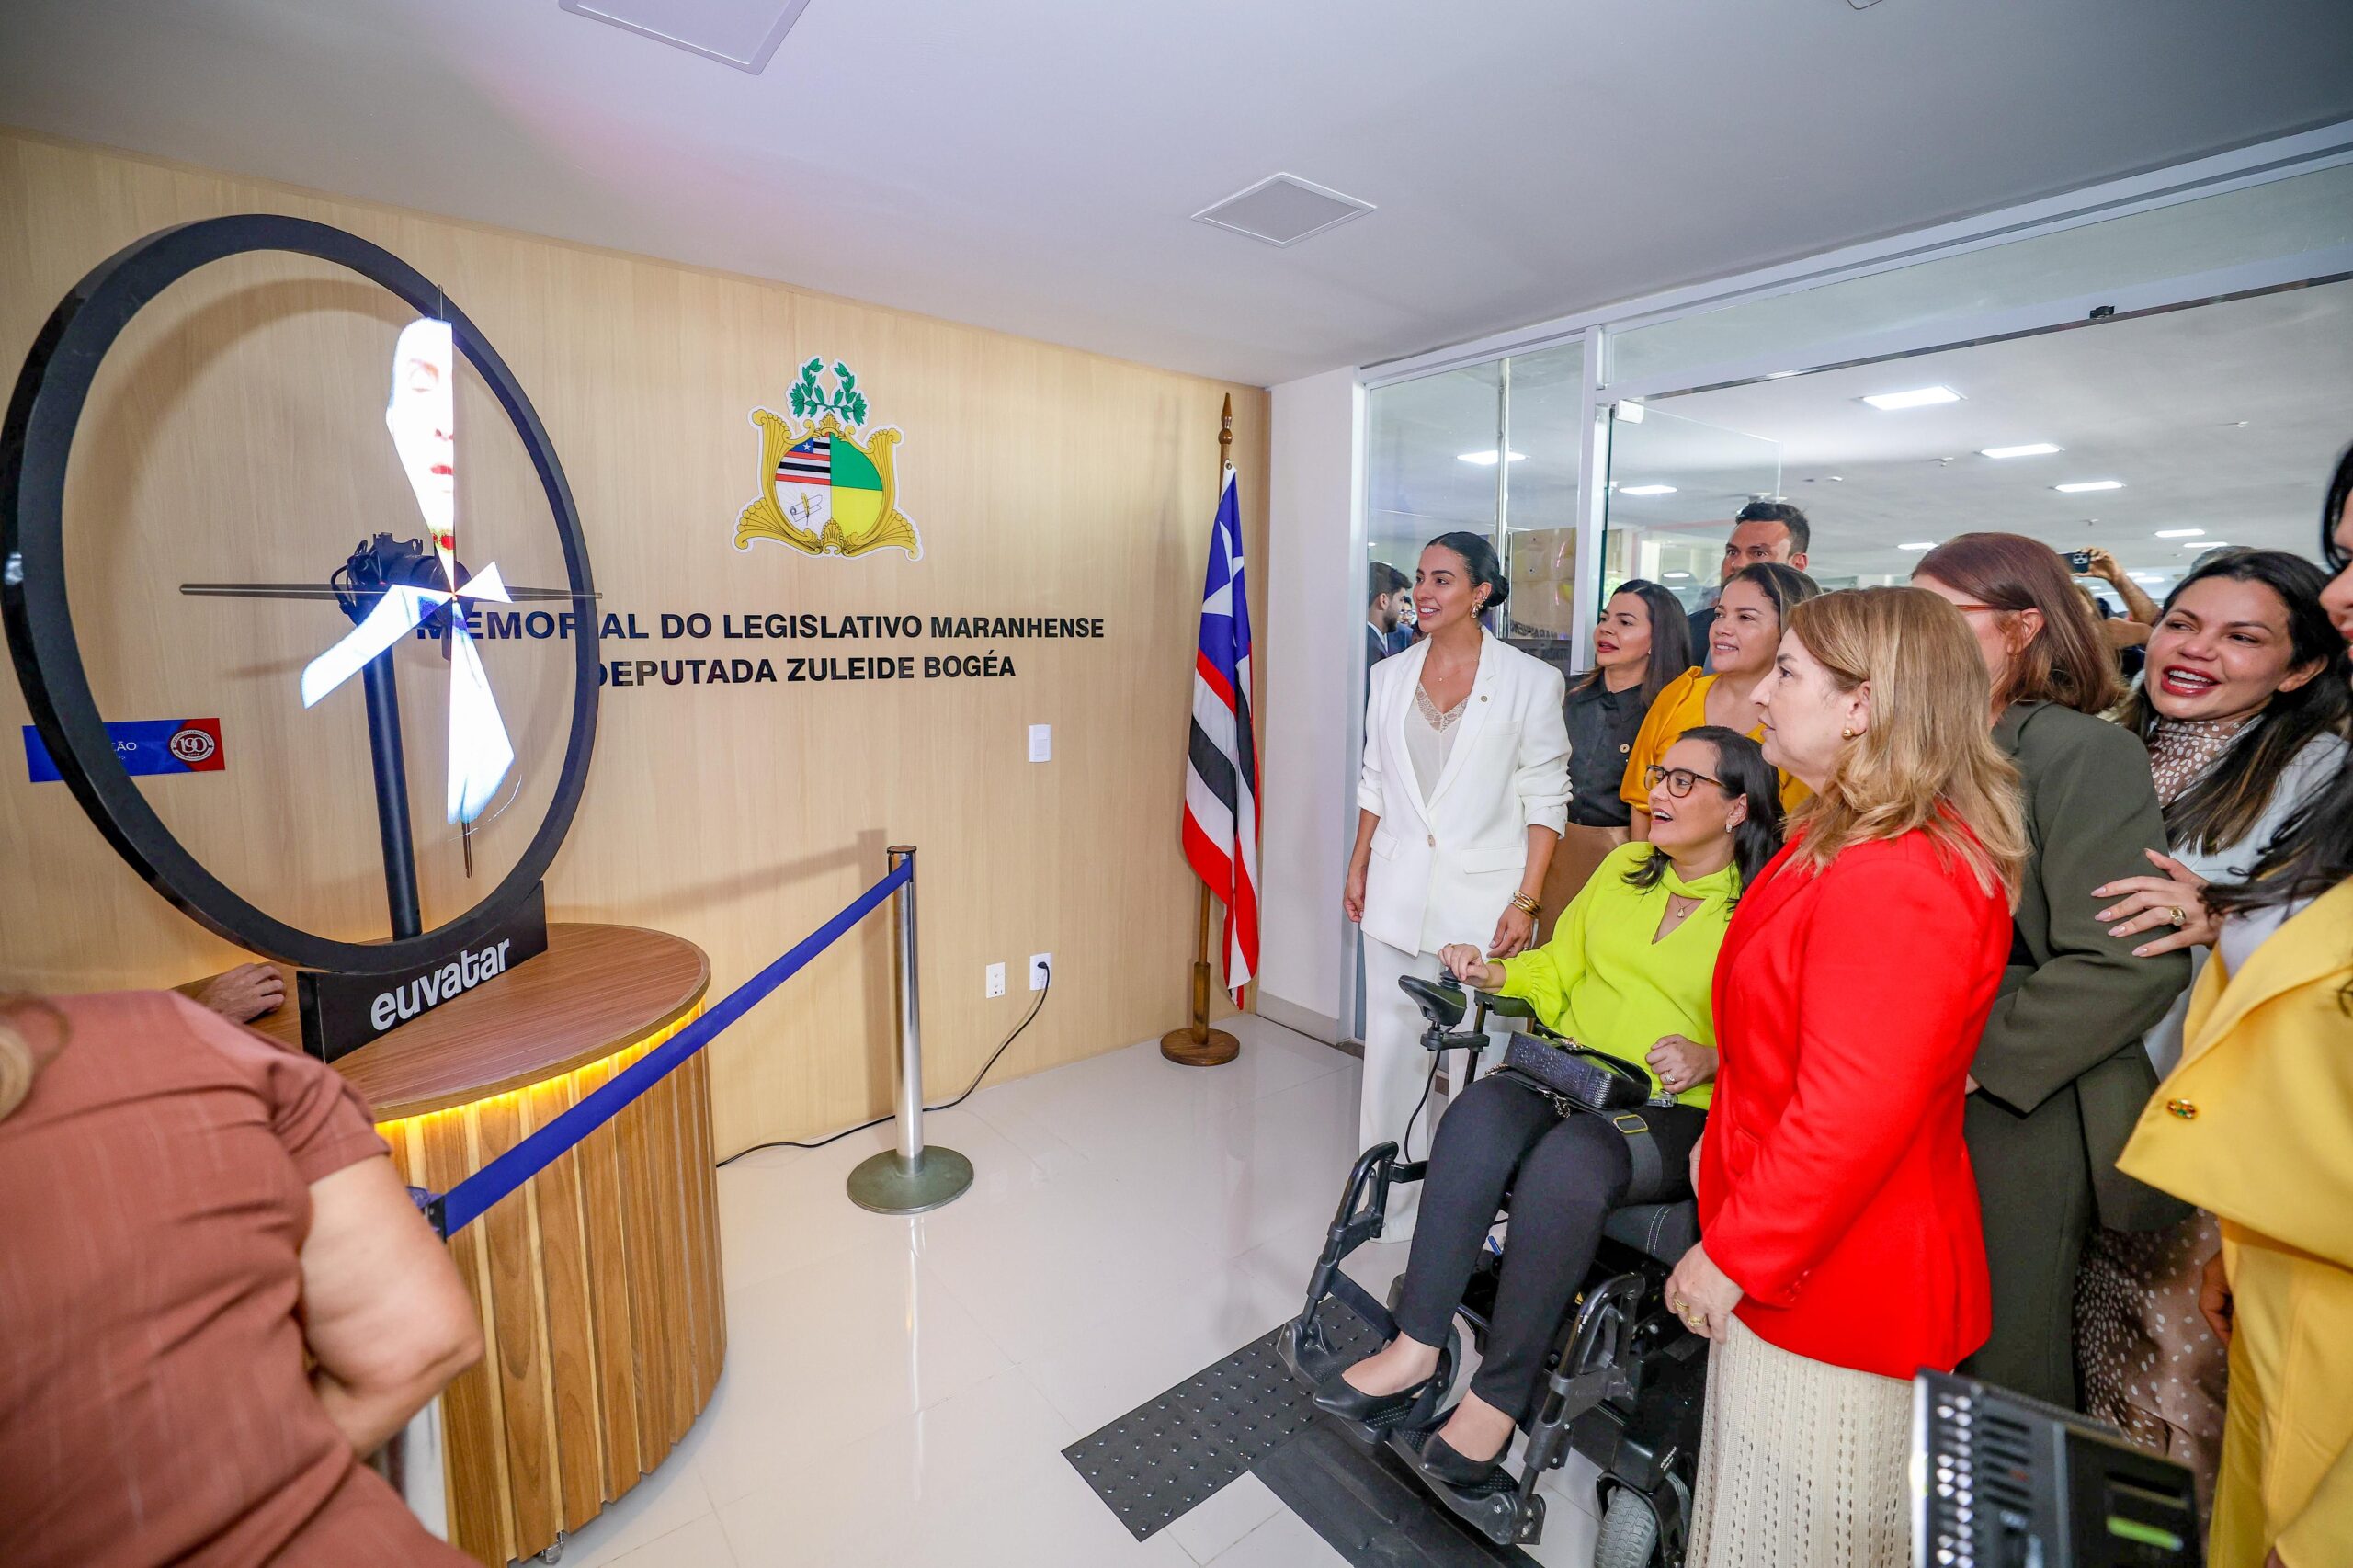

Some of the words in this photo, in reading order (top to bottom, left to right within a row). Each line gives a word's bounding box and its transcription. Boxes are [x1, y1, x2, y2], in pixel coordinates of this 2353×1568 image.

[660, 613, 712, 639] DO
[723, 614, 923, 639] LEGISLATIVO
[930, 616, 1105, 639] MARANHENSE
[786, 657, 915, 682] ZULEIDE
[924, 649, 1017, 678] BOGÉA
[179, 737, 209, 754] 190
[370, 938, 510, 1031] euvatar
